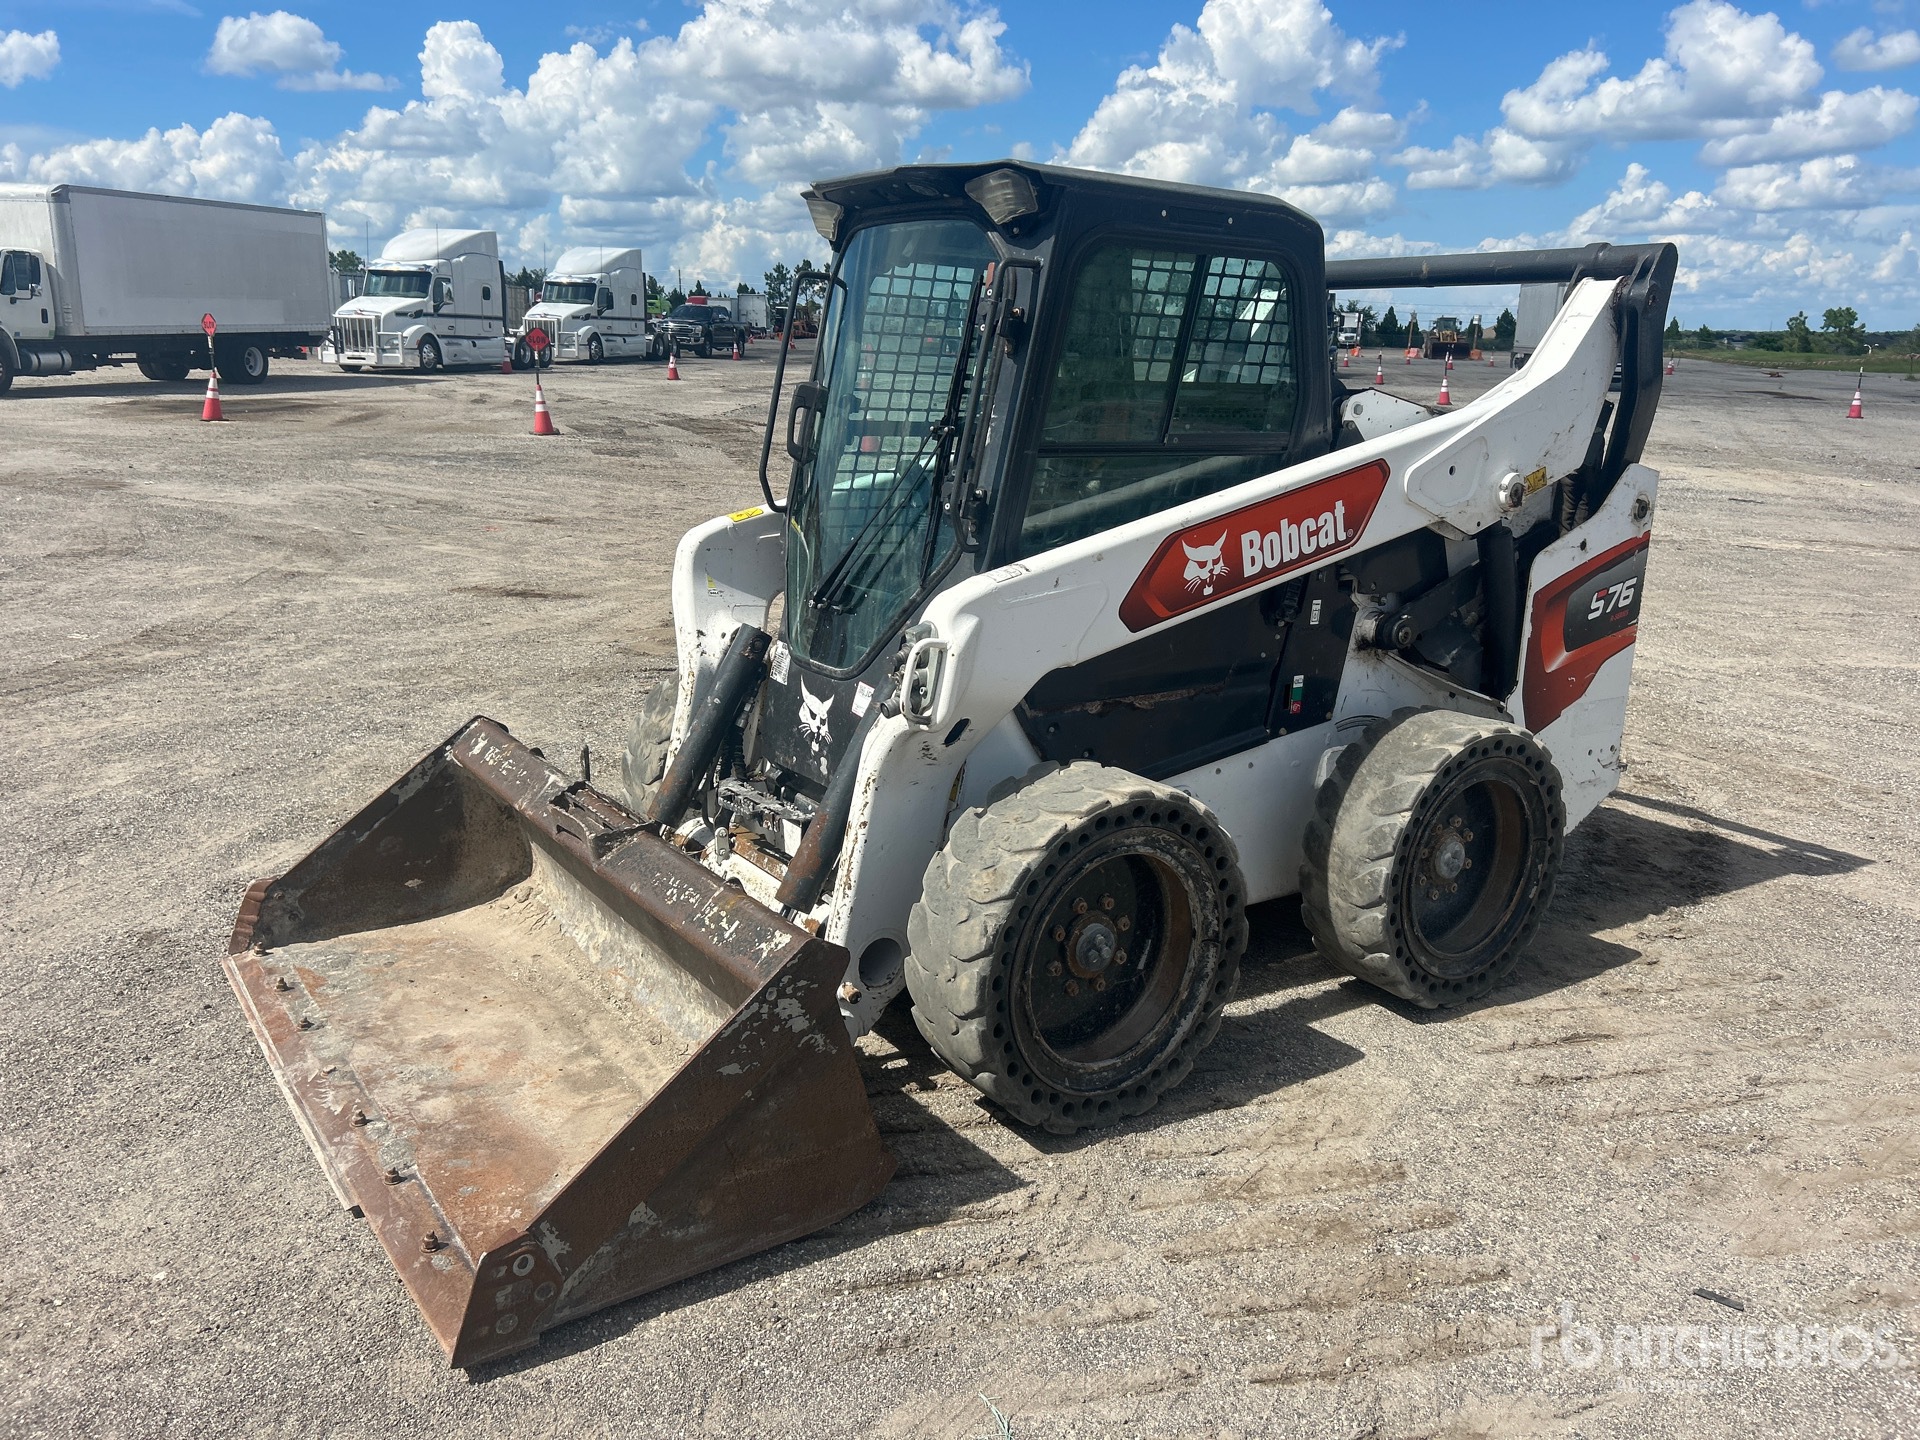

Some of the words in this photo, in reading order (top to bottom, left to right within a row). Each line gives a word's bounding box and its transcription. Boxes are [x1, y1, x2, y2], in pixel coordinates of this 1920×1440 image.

[528, 335, 546, 344] SLOW
[1241, 500, 1347, 578] Bobcat
[1588, 577, 1638, 620] S76
